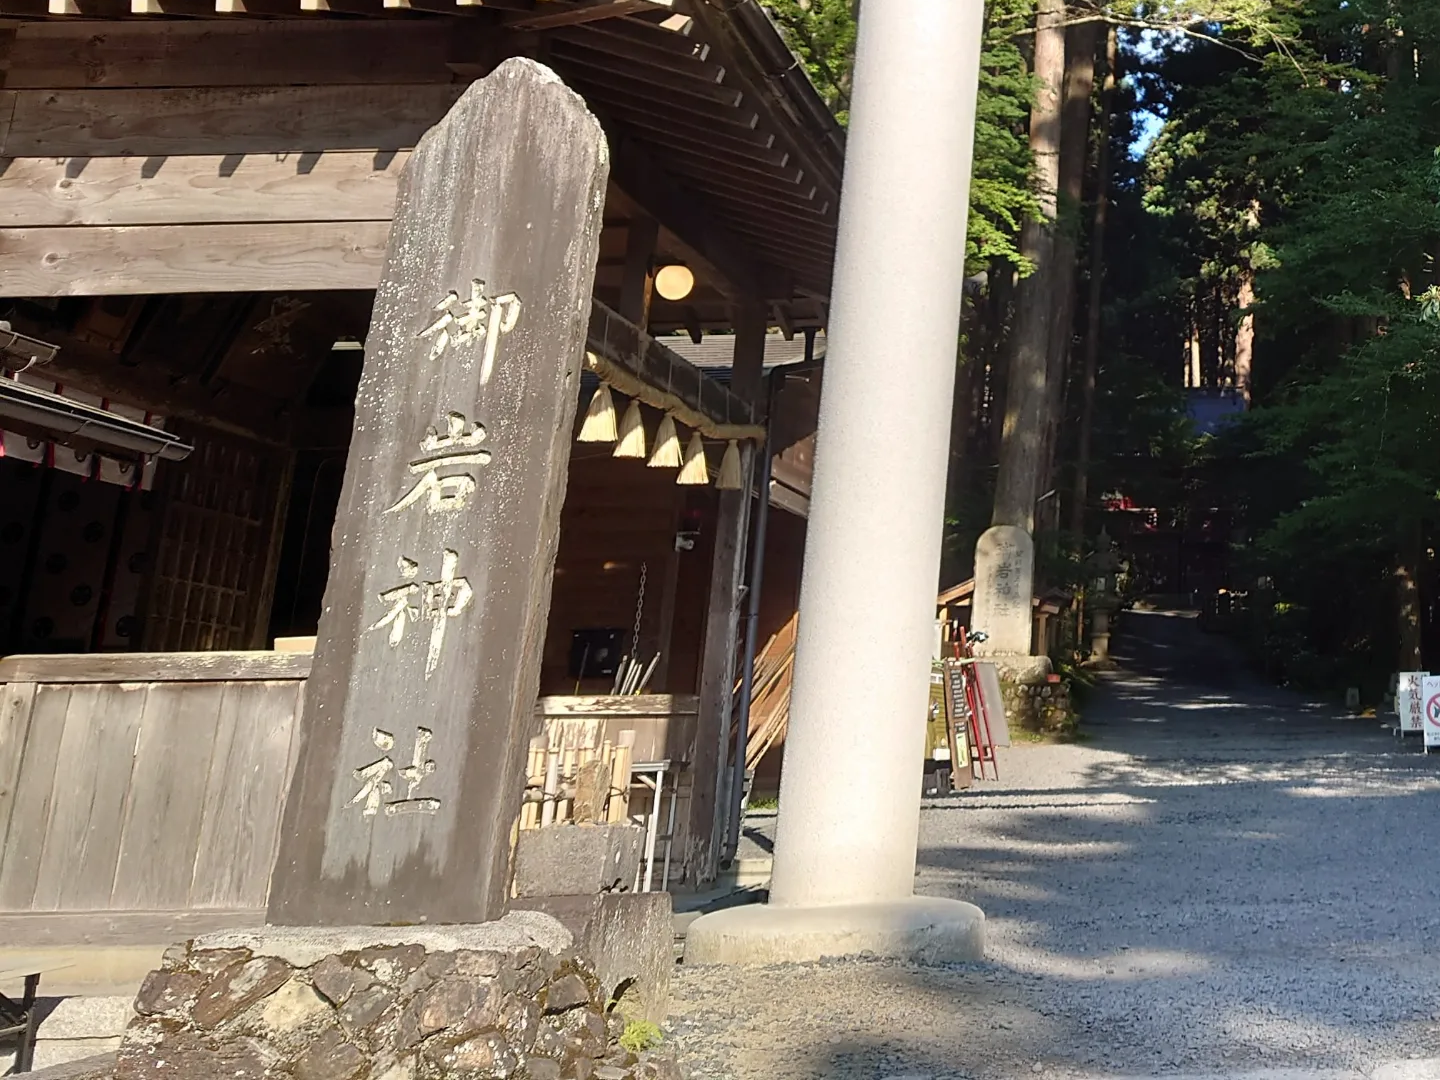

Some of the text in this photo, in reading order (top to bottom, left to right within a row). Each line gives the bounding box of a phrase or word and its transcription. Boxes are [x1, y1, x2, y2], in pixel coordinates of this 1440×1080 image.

[343, 278, 522, 817] 御岩神社
[1408, 675, 1422, 728] 火気厳禁
